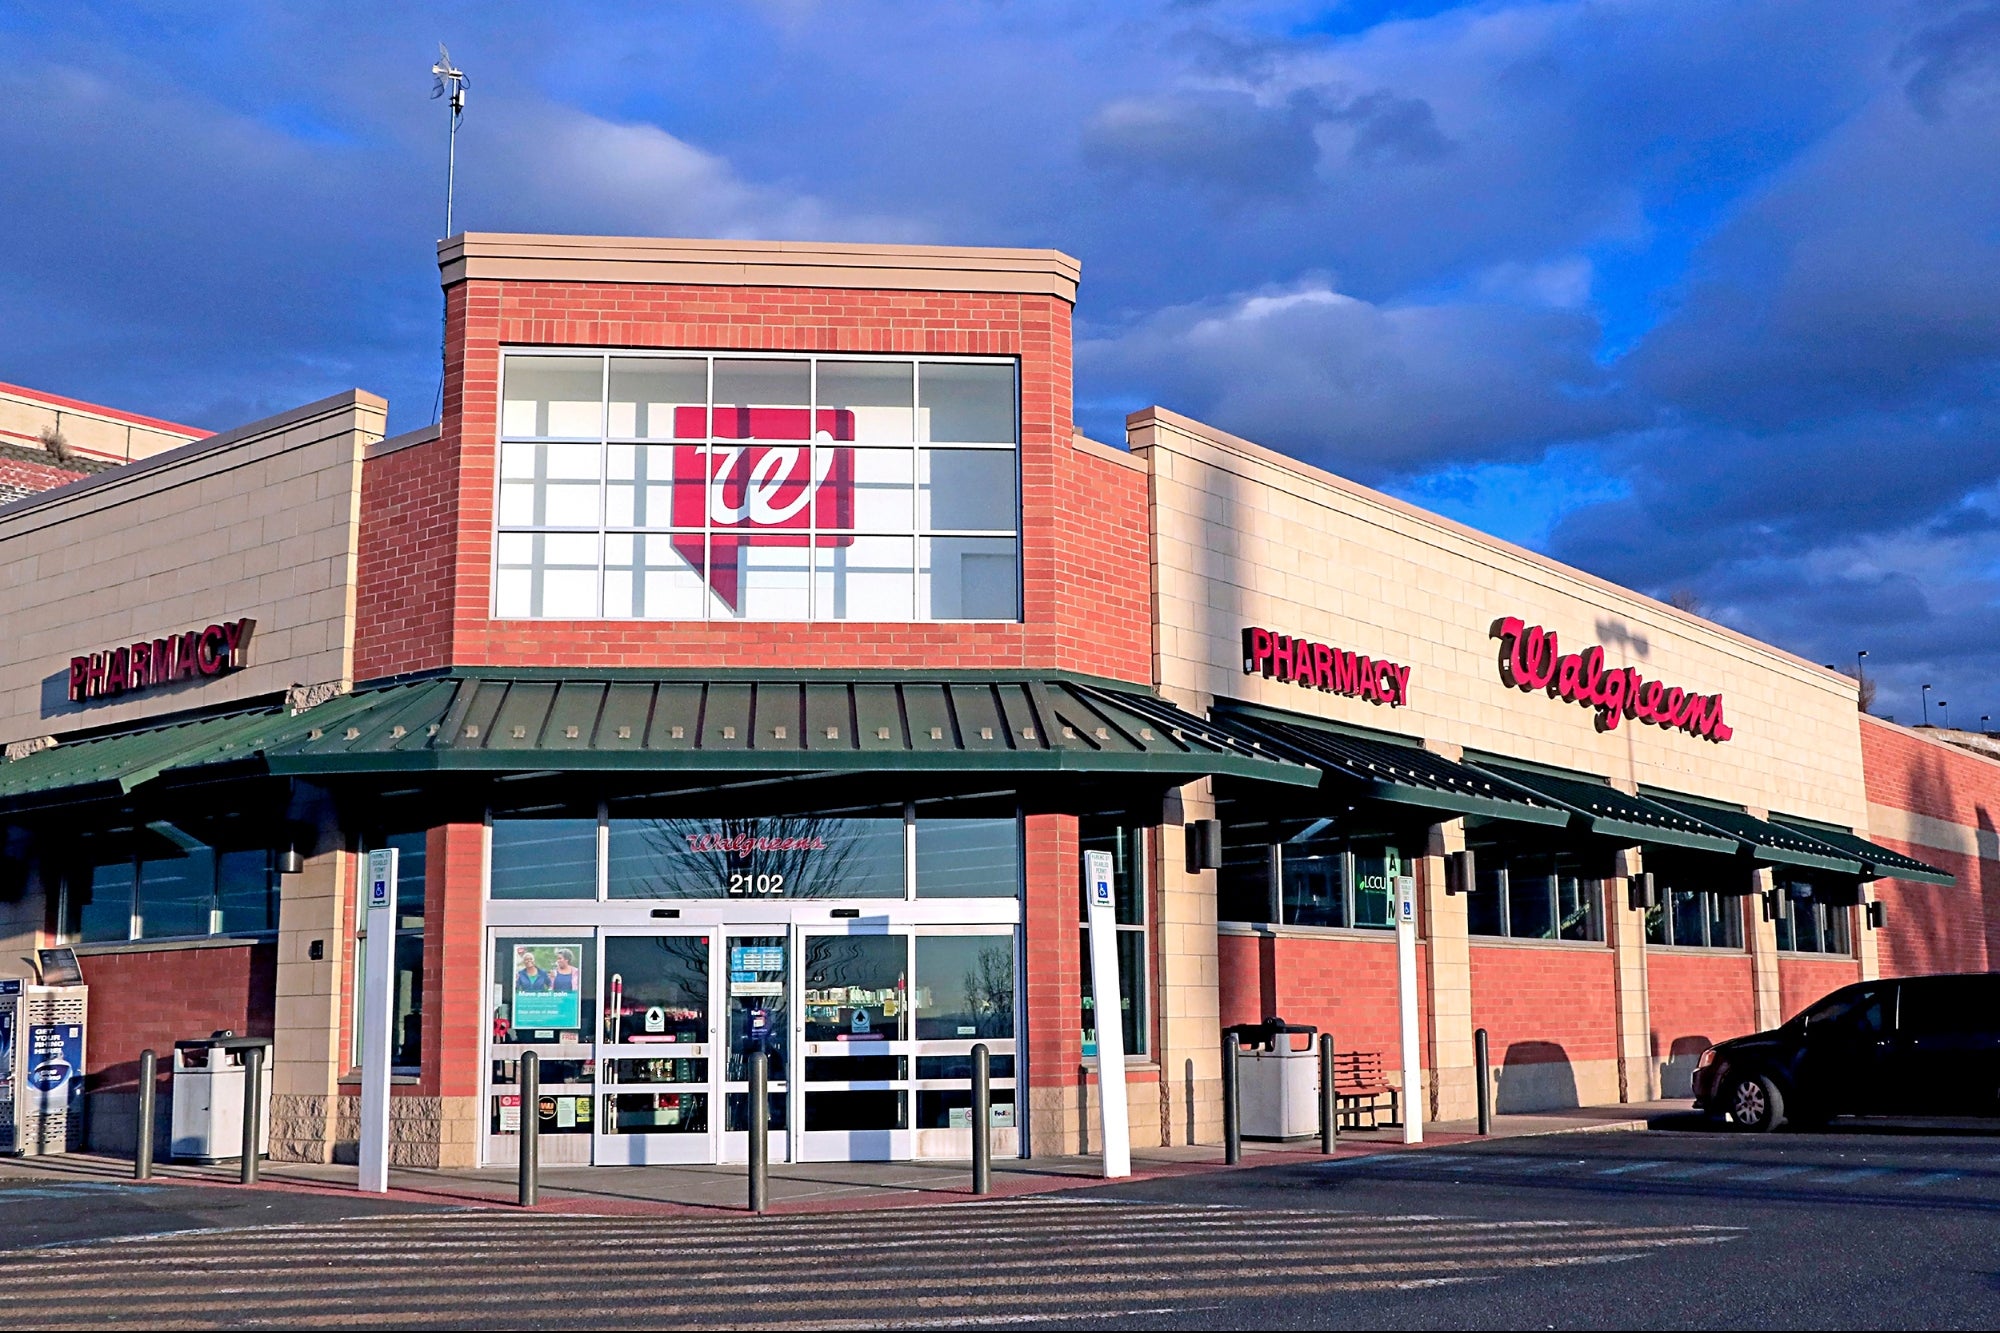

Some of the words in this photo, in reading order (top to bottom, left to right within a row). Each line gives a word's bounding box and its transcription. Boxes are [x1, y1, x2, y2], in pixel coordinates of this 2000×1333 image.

[68, 617, 254, 701] PHARMACY
[1245, 627, 1411, 706] PHARMACY
[1492, 616, 1733, 741] Walgreens
[686, 833, 827, 858] Walgreens
[729, 874, 784, 893] 2102
[1364, 875, 1387, 890] LCCU
[538, 990, 552, 998] past
[553, 990, 568, 998] pain
[34, 1028, 54, 1036] GET
[561, 1033, 577, 1041] FREE
